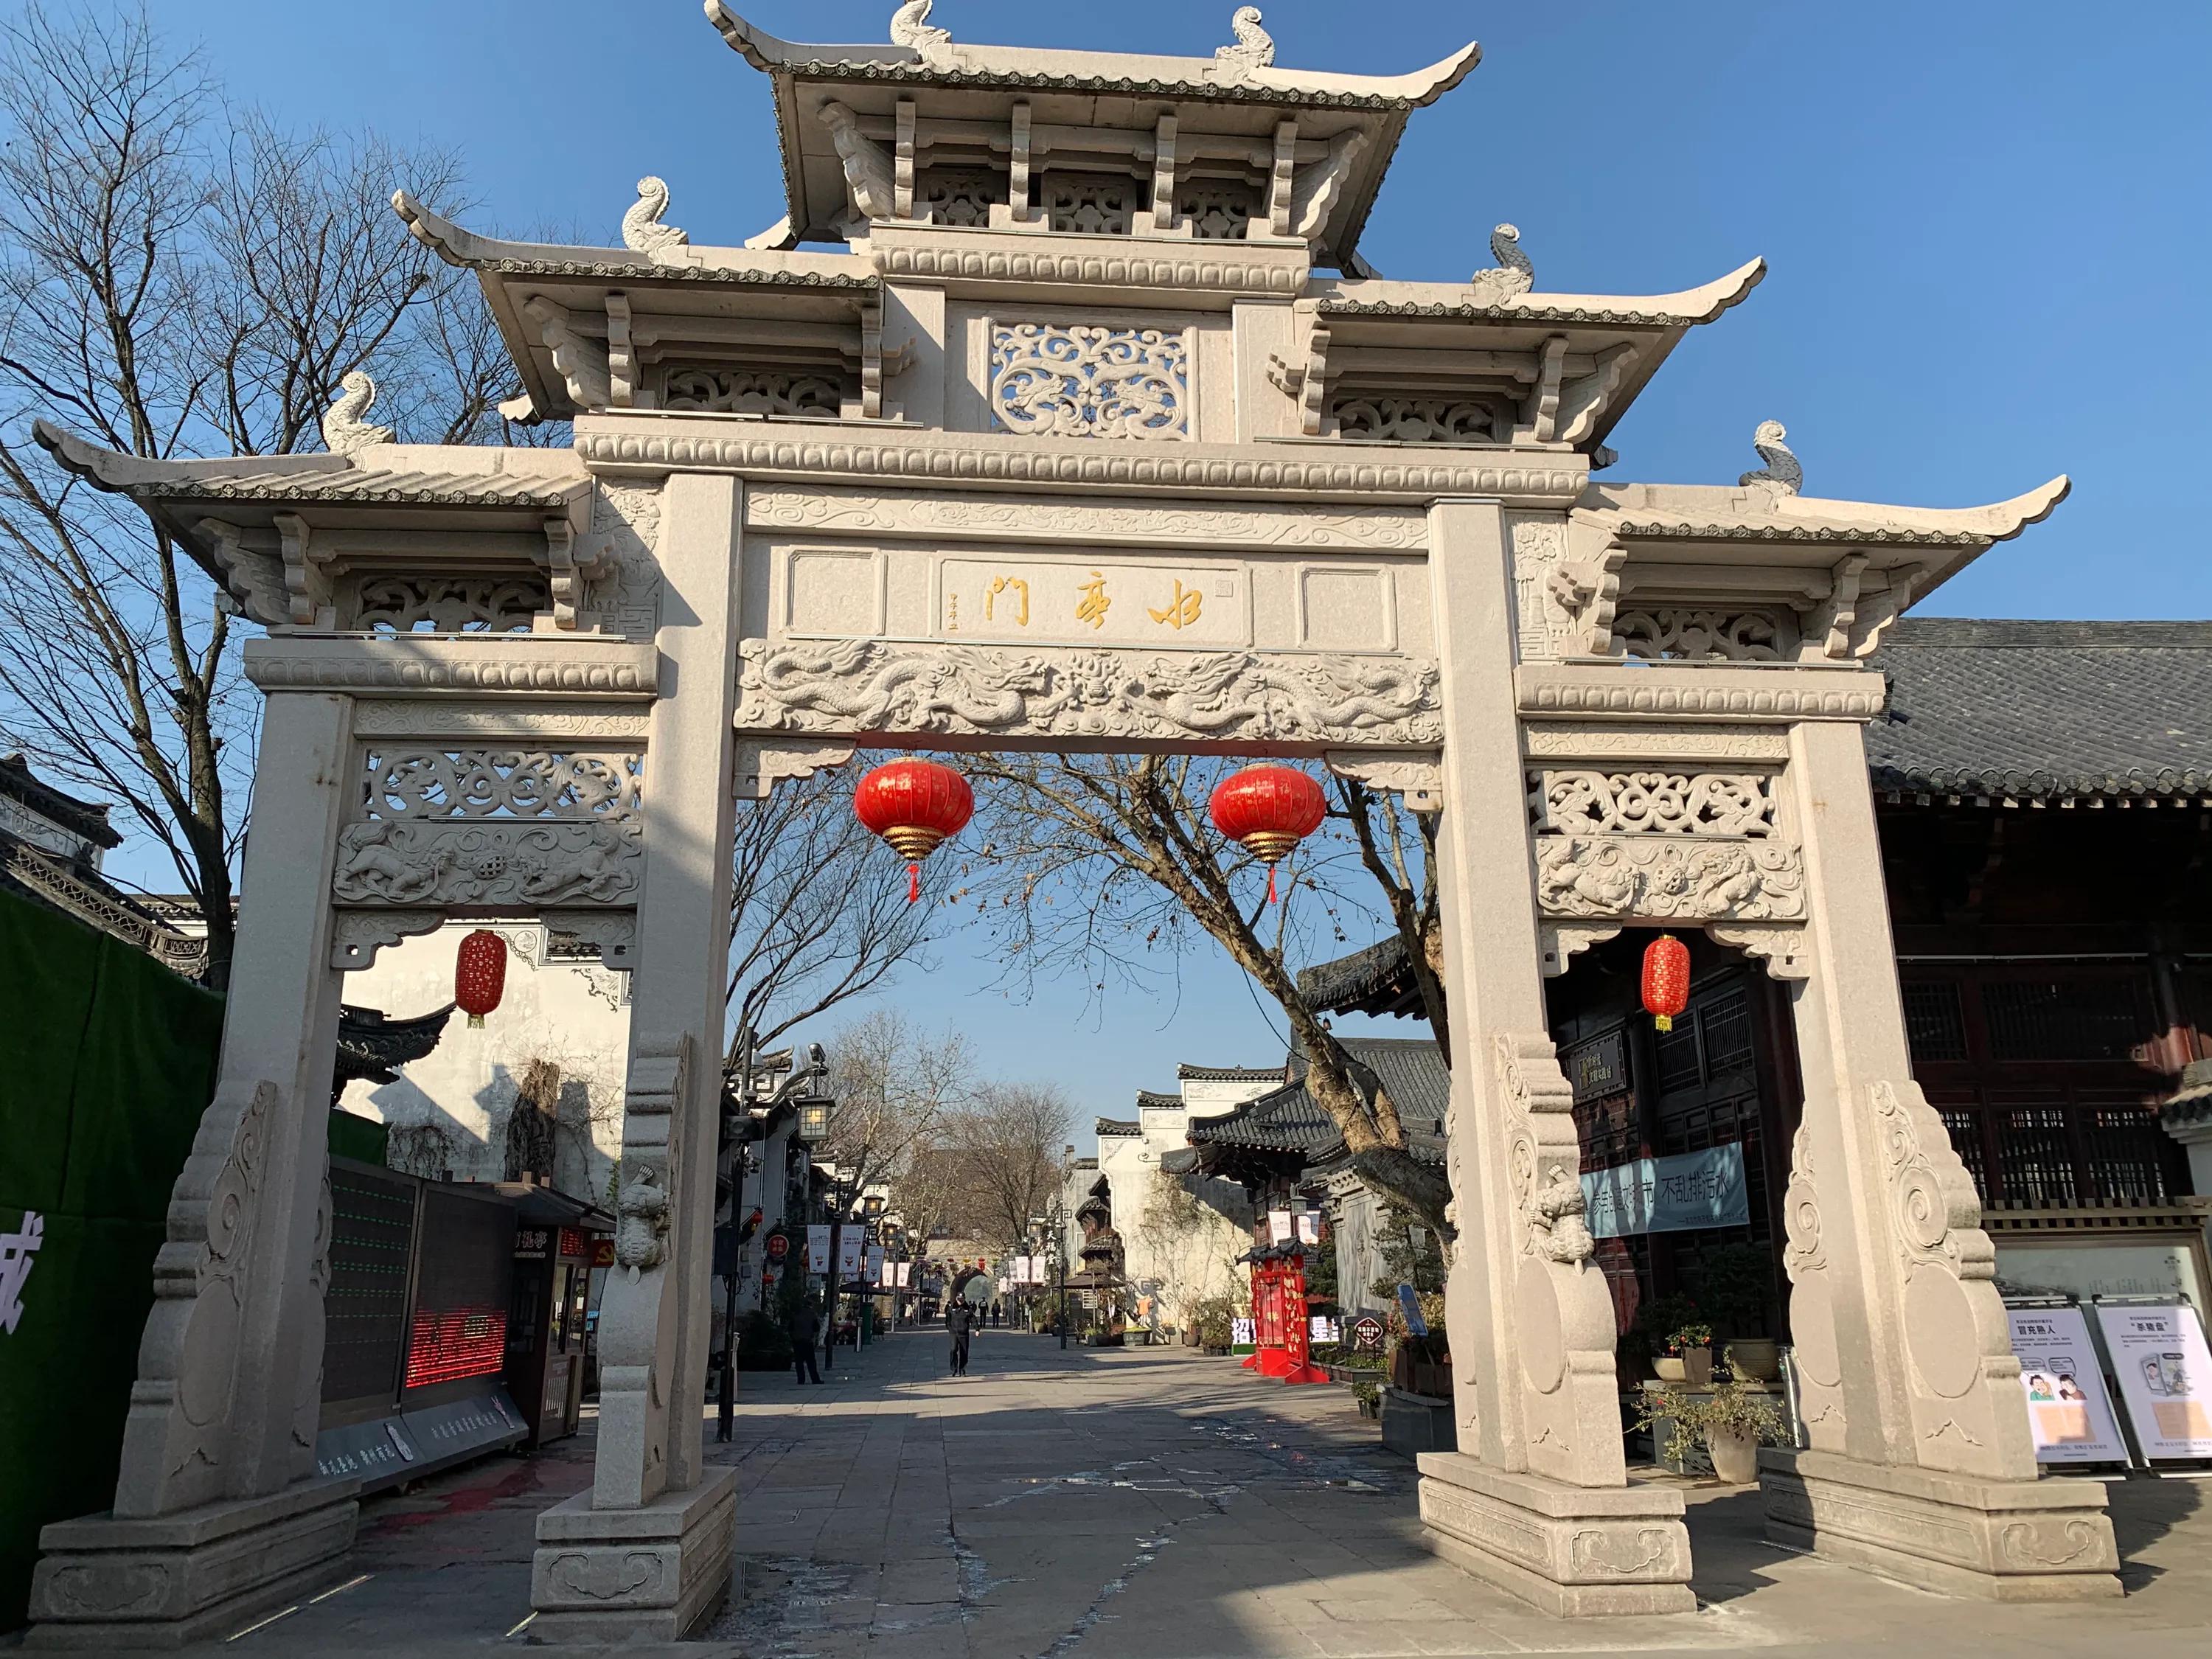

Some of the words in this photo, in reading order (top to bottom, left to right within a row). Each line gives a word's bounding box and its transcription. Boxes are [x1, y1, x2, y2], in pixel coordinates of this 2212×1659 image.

[1661, 1166, 1730, 1205] 不乱排污水
[2017, 1325, 2056, 1335] 冒充熟人
